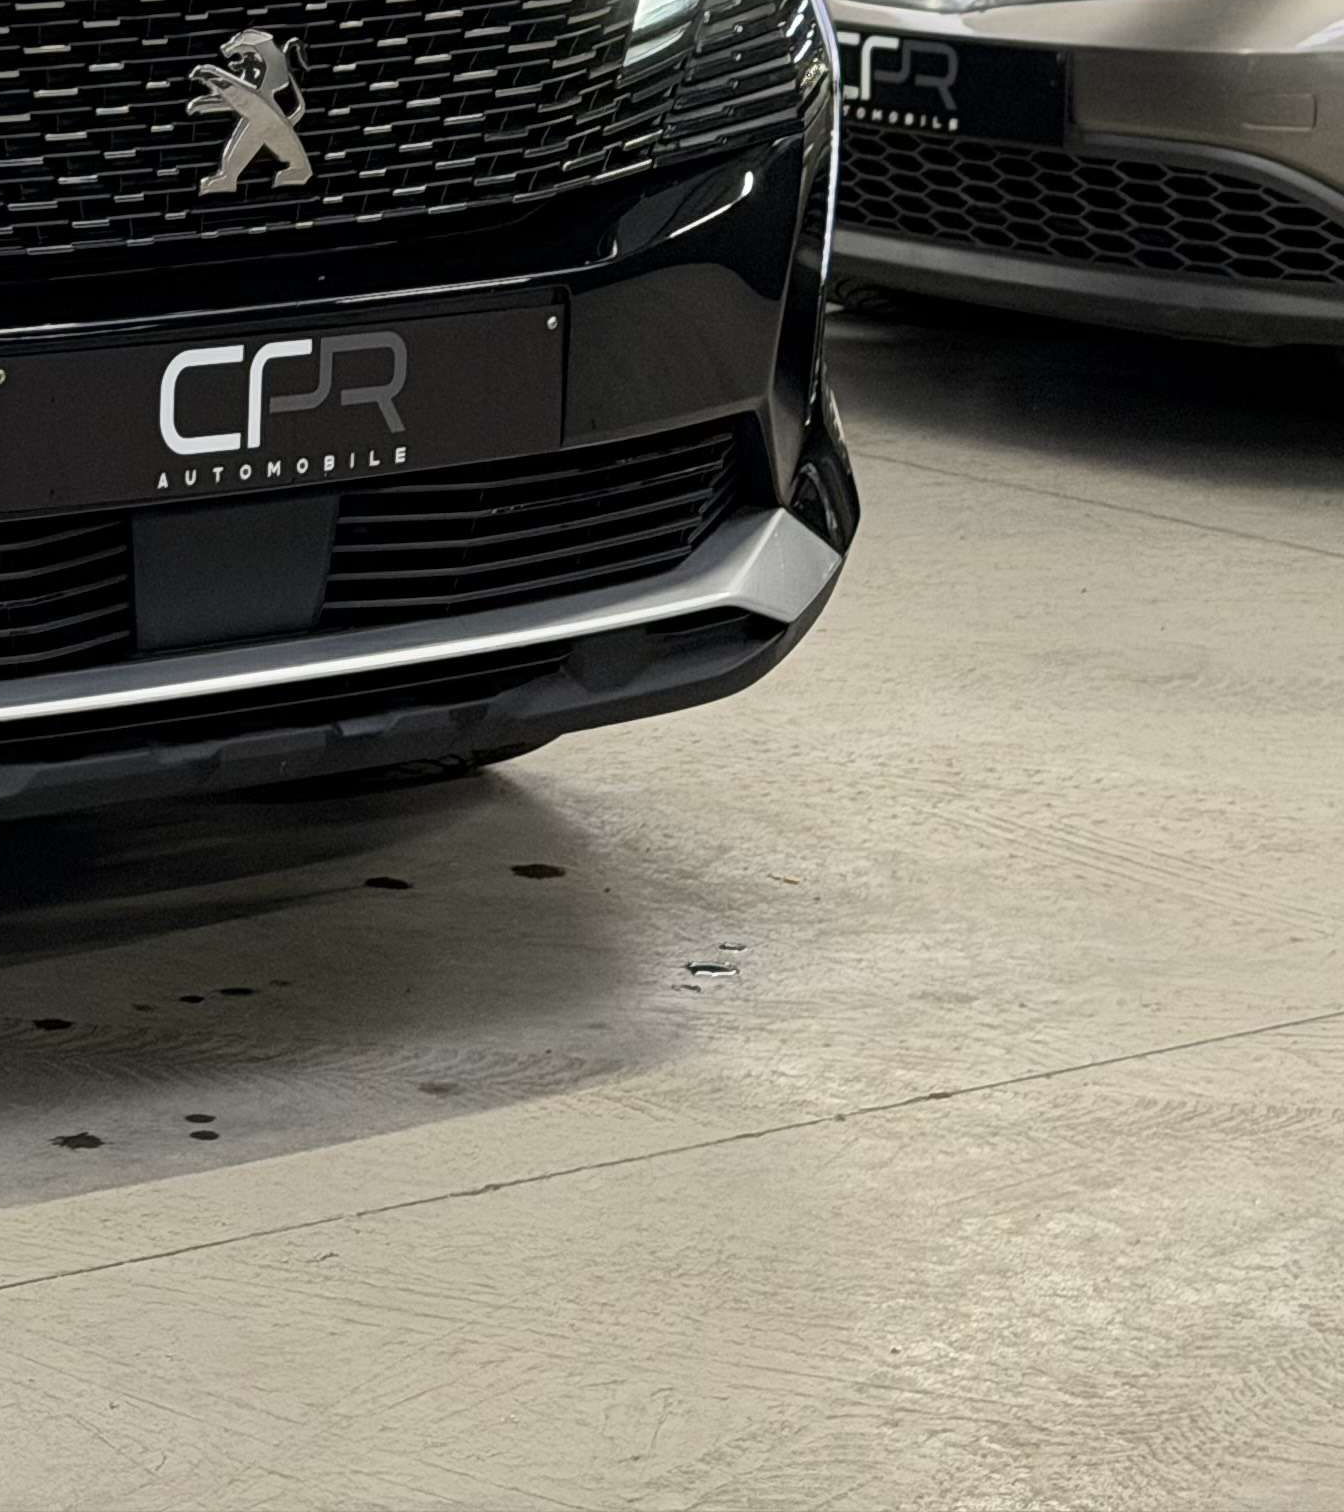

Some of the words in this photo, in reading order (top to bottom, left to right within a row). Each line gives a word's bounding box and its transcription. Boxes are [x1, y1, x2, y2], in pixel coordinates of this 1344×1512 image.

[843, 104, 959, 131] TOMOBILE
[160, 331, 407, 455] CPR
[157, 446, 407, 489] AUTOMOBILE
